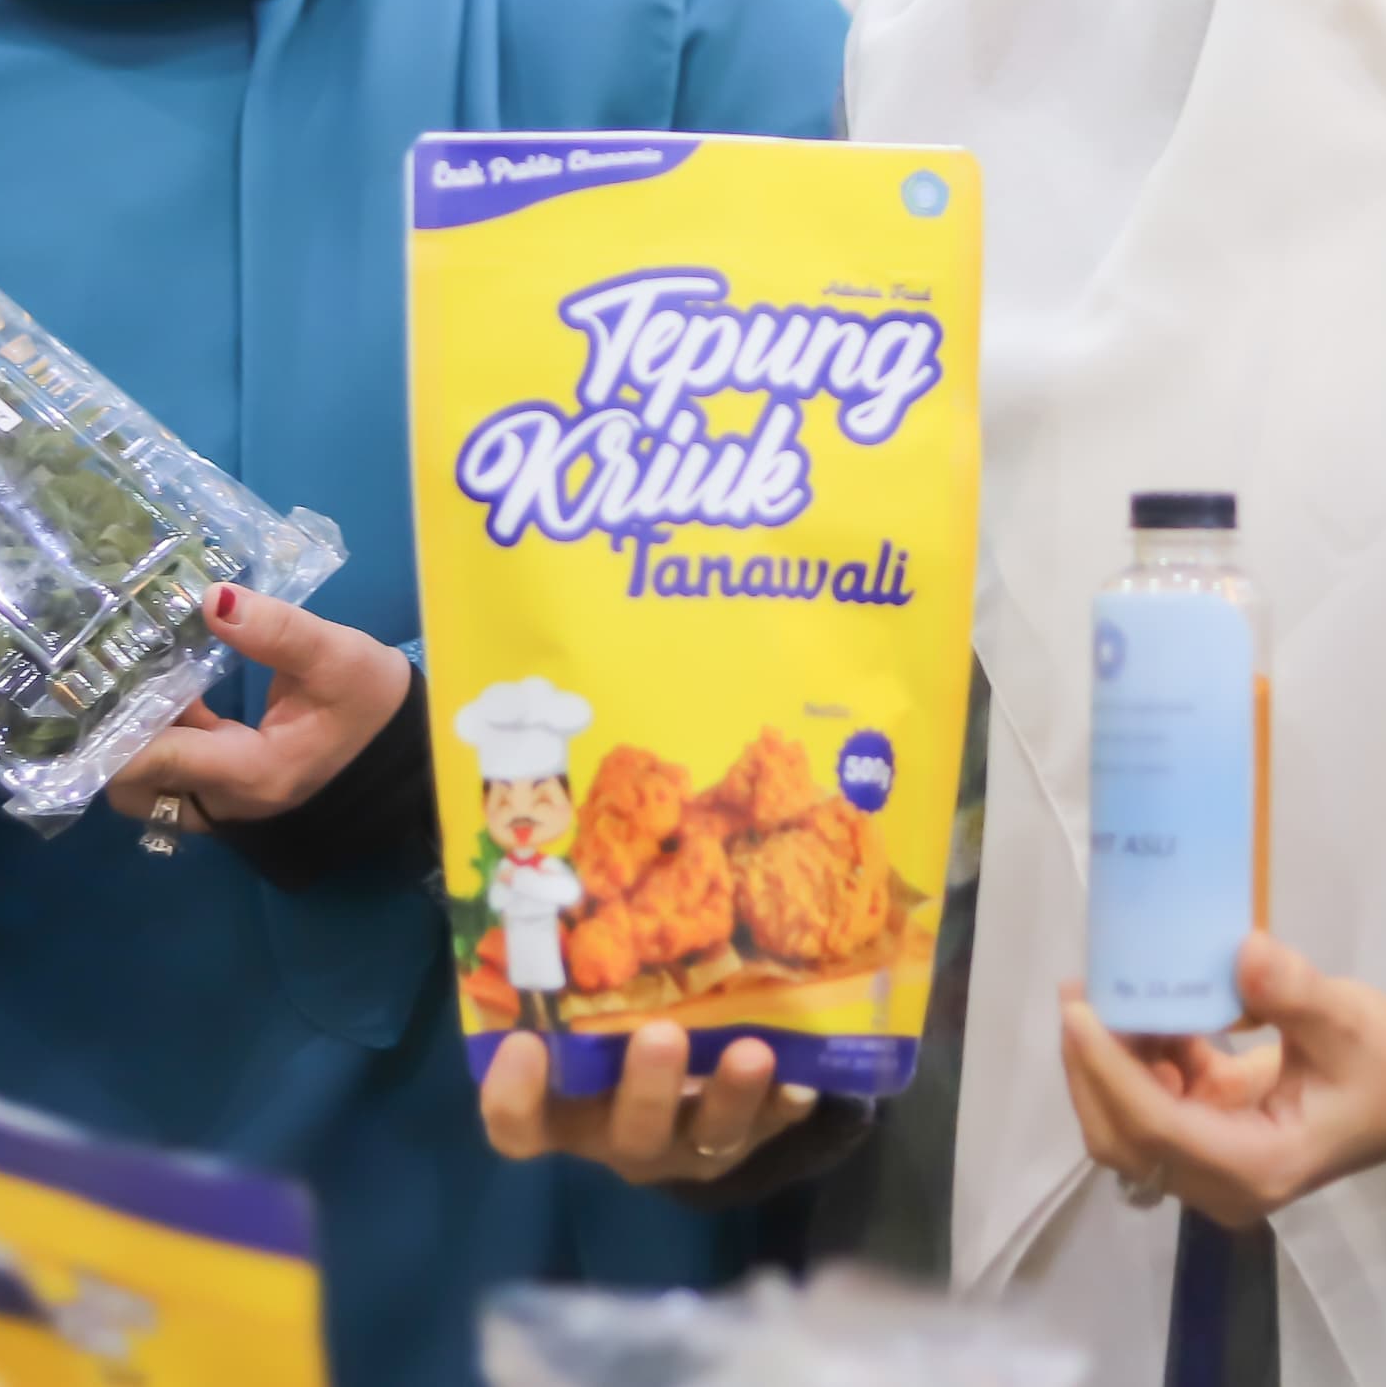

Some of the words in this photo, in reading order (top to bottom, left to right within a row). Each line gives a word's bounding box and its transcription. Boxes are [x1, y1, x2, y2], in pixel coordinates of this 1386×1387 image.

[561, 270, 941, 440] Tepung
[460, 401, 808, 544] Kriuk
[611, 524, 915, 606] Tanawali
